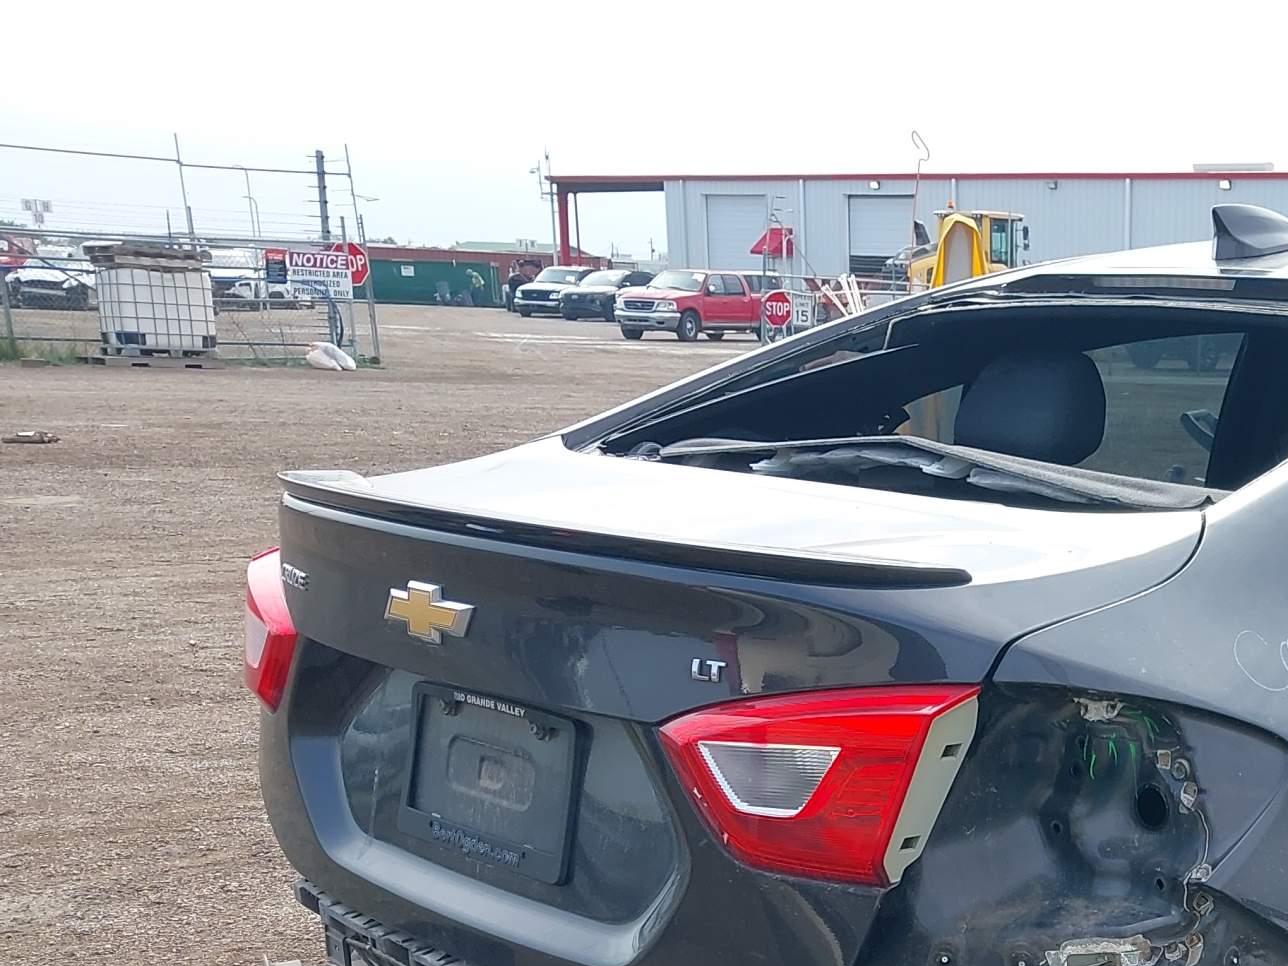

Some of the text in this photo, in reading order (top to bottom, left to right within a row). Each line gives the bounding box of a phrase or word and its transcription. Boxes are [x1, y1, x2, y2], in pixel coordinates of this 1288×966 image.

[292, 253, 347, 269] NOTICE
[348, 255, 364, 272] OP
[293, 268, 331, 278] RESTRICTED
[332, 271, 349, 279] AREA
[333, 289, 350, 297] ONLY
[765, 301, 790, 317] STOP
[795, 309, 809, 323] 15
[691, 658, 727, 683] LT
[466, 694, 496, 710] GRANDE
[496, 702, 526, 717] VALLEY
